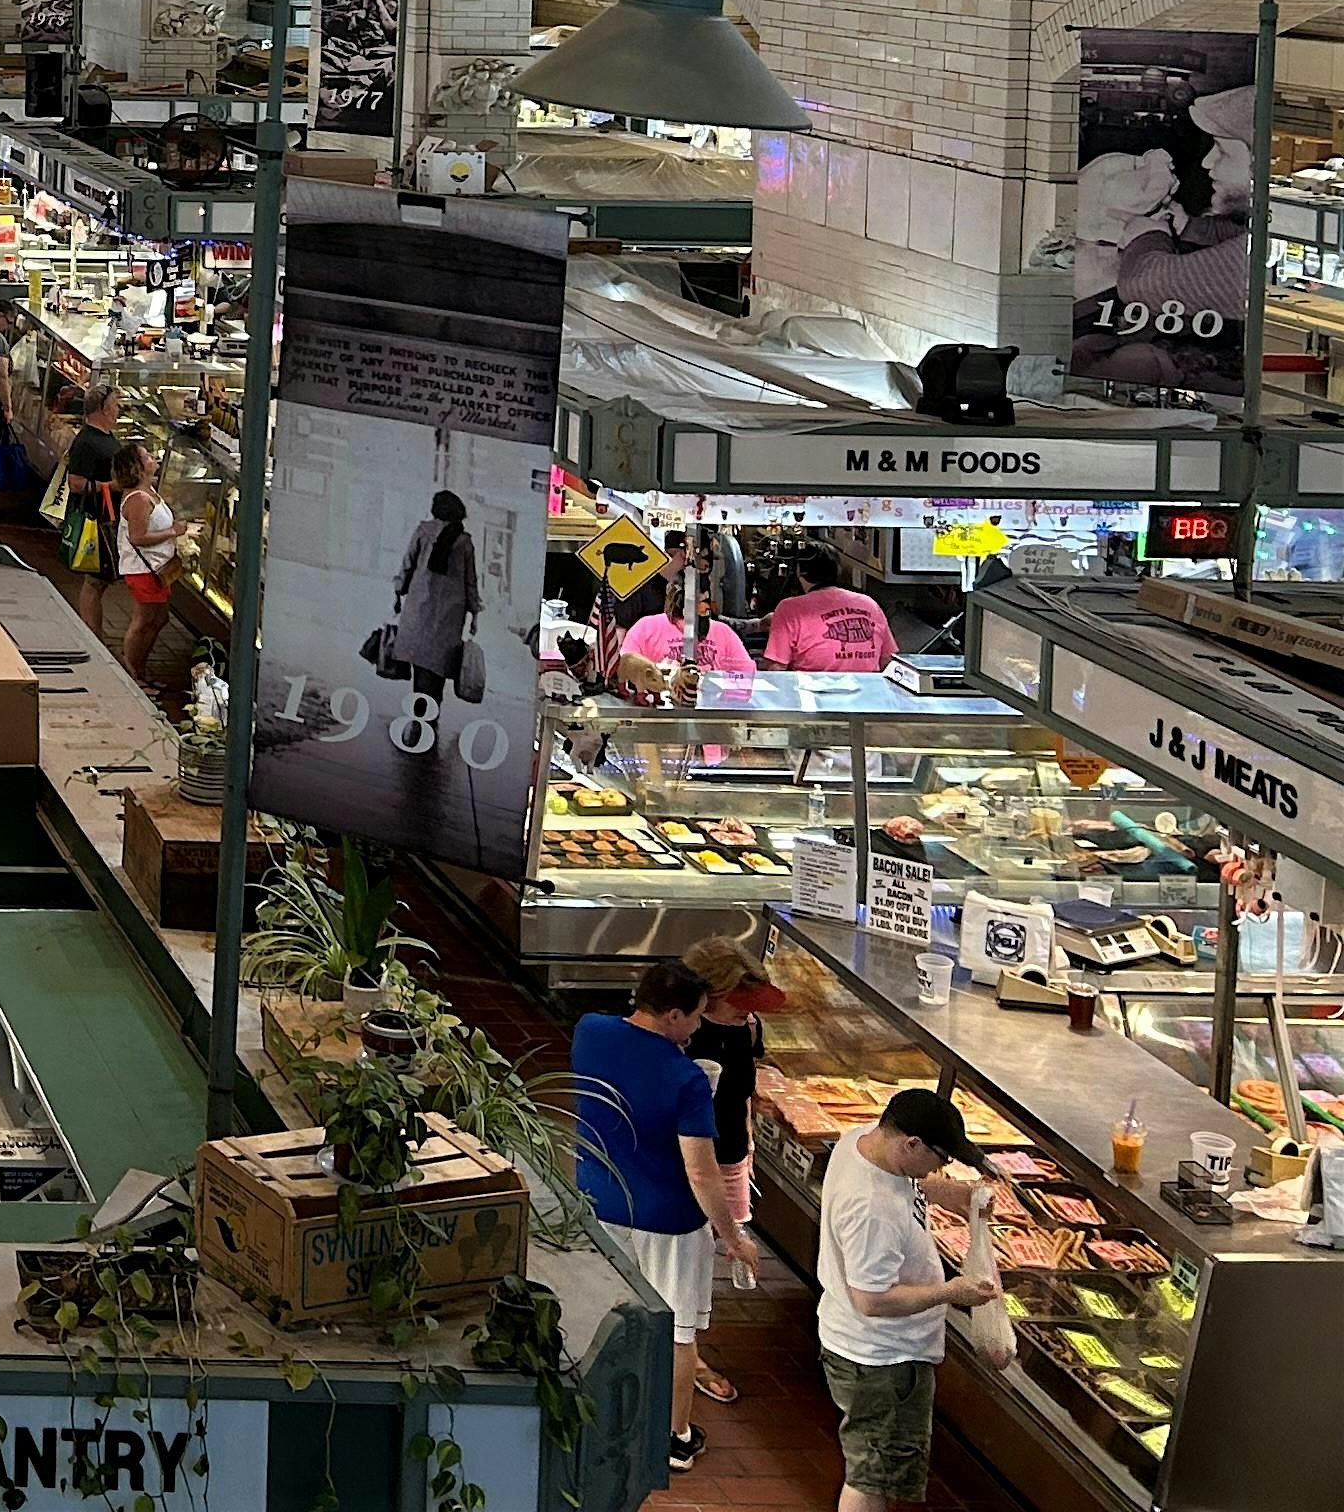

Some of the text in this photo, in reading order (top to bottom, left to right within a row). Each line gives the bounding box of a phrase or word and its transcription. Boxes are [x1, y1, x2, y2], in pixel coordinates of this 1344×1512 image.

[327, 88, 384, 112] 1977
[1092, 298, 1224, 339] 1980
[361, 355, 384, 368] ANY
[391, 360, 419, 374] ITEM
[428, 366, 496, 387] PURCHASED
[388, 345, 437, 363] PATRONS
[444, 354, 458, 367] TO
[464, 358, 517, 377] RECHECK
[525, 369, 549, 382] THE
[450, 396, 502, 415] MARKET
[507, 407, 552, 424] OFFICE
[495, 390, 535, 408] SCALE
[846, 449, 1042, 475] M & M FOODS
[1173, 521, 1227, 541] BBQ
[272, 673, 511, 772] 1980
[1149, 718, 1299, 820] J & J MEATS
[872, 856, 931, 883] BACON SALE!
[886, 888, 913, 903] BACON
[892, 879, 907, 890] ALL
[896, 901, 911, 913] OFF
[894, 912, 911, 924] YOU
[912, 916, 929, 928] BUY
[894, 923, 905, 934] OR
[907, 926, 929, 940] MORE
